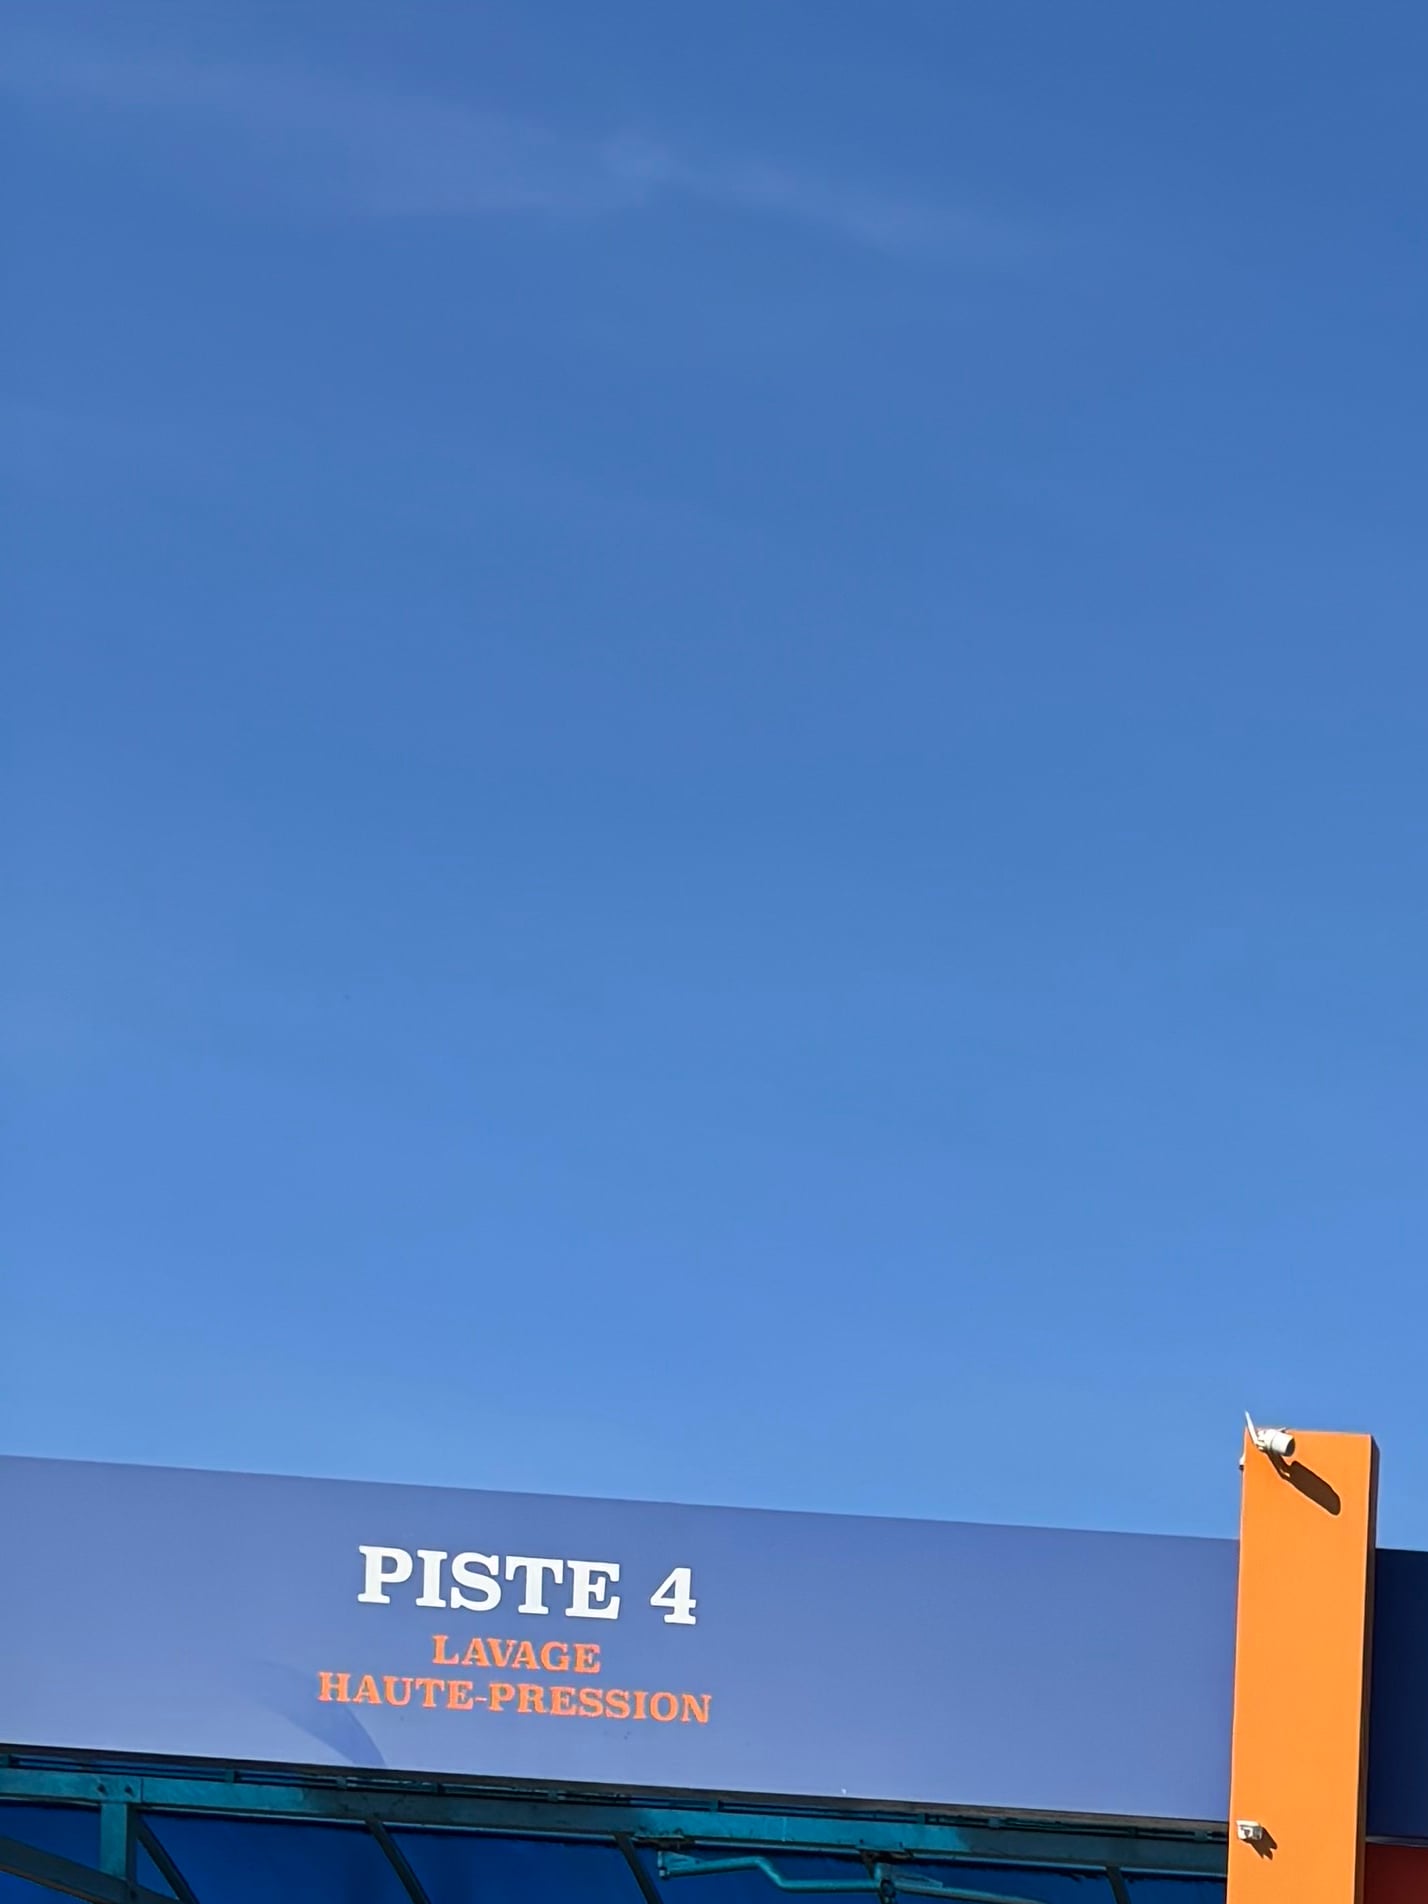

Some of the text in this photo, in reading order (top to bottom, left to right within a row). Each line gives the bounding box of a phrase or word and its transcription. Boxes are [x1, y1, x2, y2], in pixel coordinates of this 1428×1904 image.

[357, 1544, 697, 1625] PISTE 4
[432, 1634, 601, 1674] LAVAGE
[317, 1671, 712, 1724] HAUTE-PRESSION
